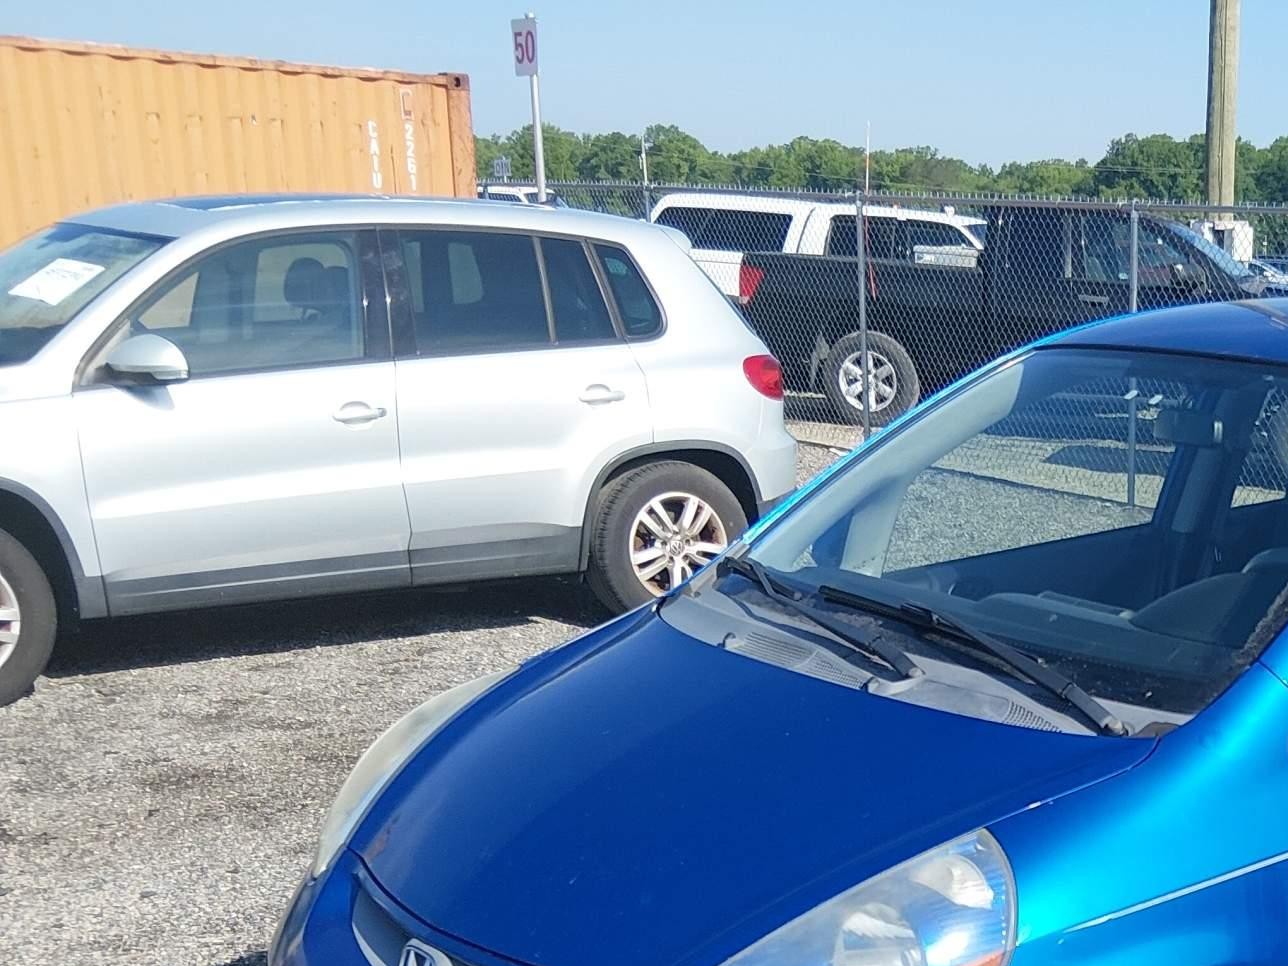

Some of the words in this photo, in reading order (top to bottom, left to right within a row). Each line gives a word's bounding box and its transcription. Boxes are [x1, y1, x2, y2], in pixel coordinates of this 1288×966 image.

[513, 29, 536, 65] 50
[367, 120, 383, 189] CAIU
[403, 122, 417, 191] 2261
